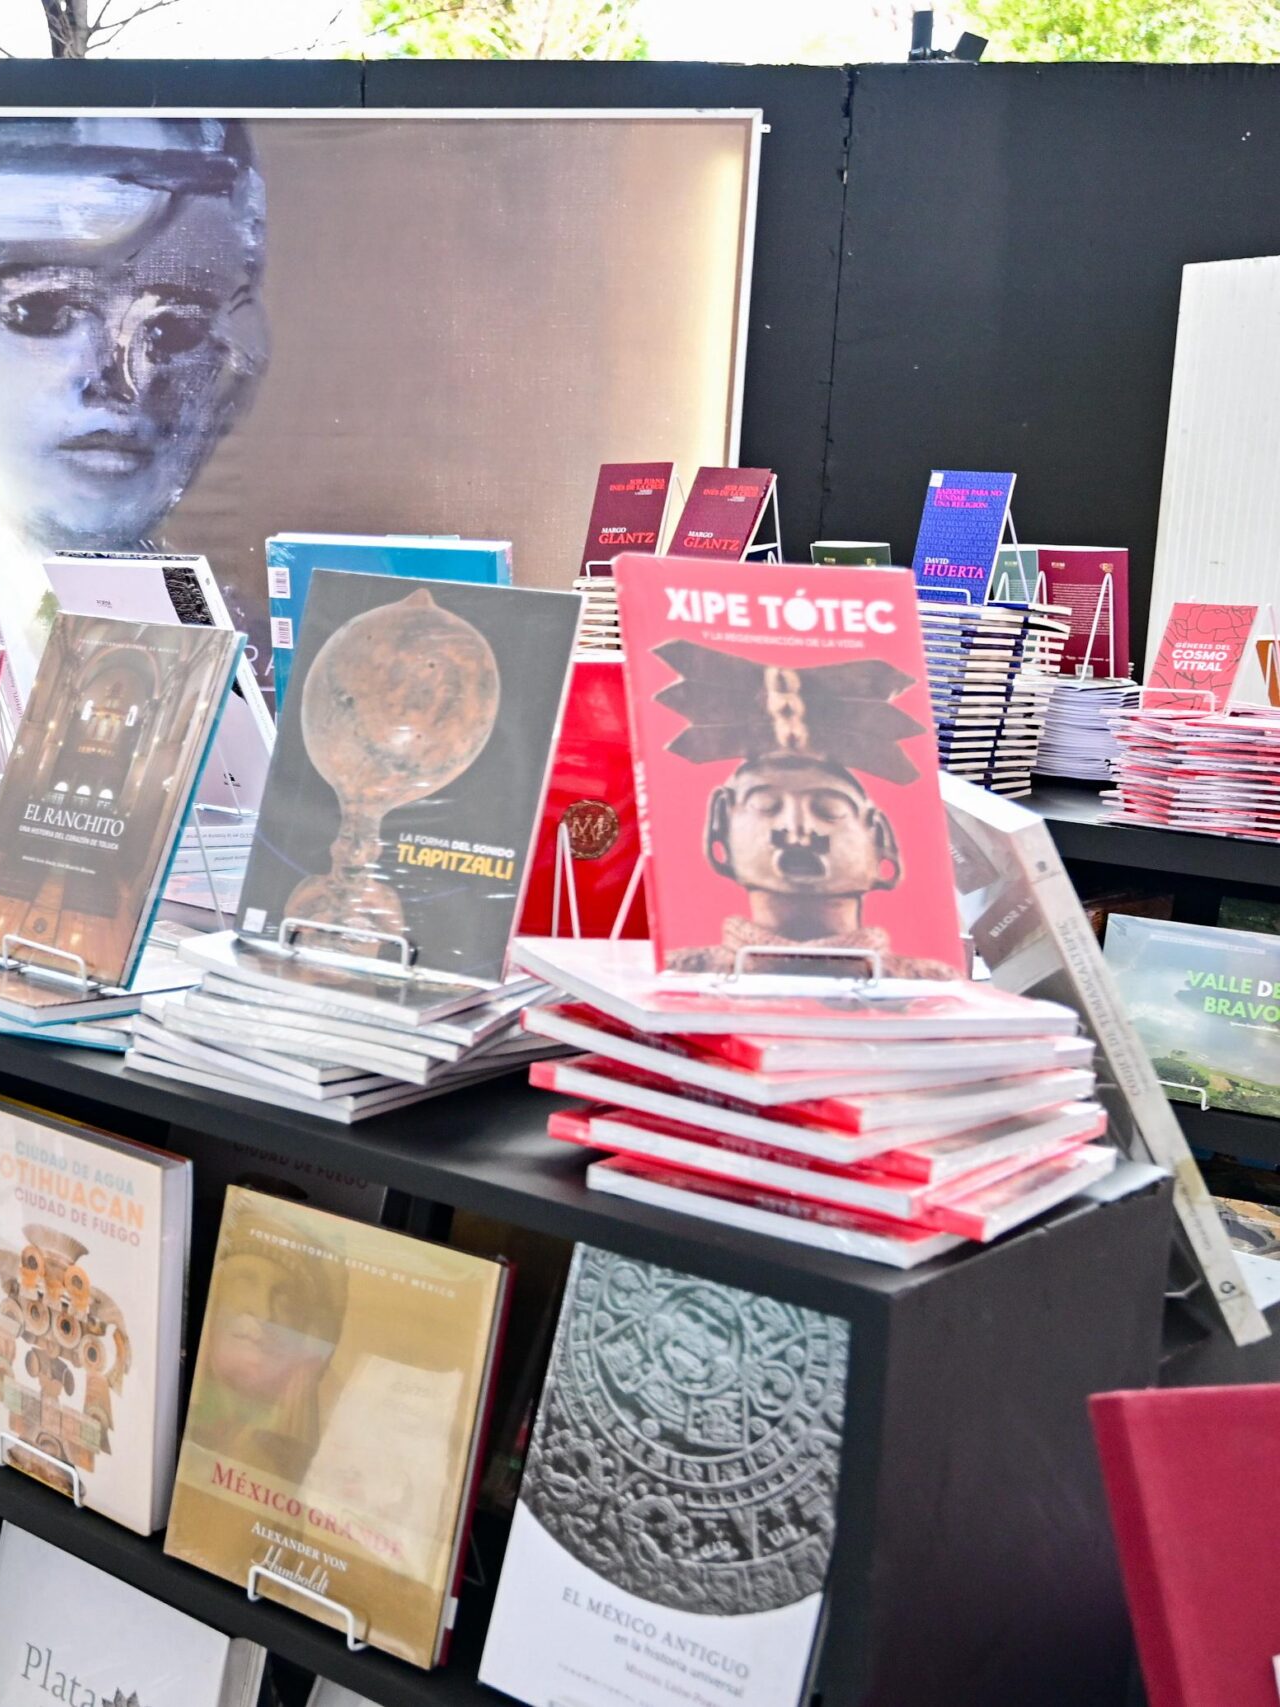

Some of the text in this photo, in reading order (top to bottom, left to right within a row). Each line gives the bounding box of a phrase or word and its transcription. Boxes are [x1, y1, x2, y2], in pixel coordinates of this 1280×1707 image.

[598, 532, 655, 545] GLANTZ
[683, 537, 740, 551] GLANTZ
[687, 530, 714, 538] MARGO
[922, 563, 985, 580] HUERTA
[925, 556, 950, 565] DAVID
[664, 587, 898, 635] XIPE TÓTEC
[1171, 649, 1228, 661] COSMO
[1172, 660, 1223, 672] VITRAL
[23, 803, 125, 838] EL RANCHITO
[396, 842, 515, 881] TLAPITZALLI
[399, 832, 516, 859] LA FORMA DEL SONIDO
[1186, 970, 1254, 995] VALLE
[1202, 996, 1280, 1023] BRAVO
[15, 1140, 135, 1196] CIUDAD DE AGUA
[14, 1186, 142, 1248] CIUDAD DE FUEGO
[344, 1256, 456, 1299] ESTADO DE MÉXICO
[211, 1460, 403, 1561] MÉXICO GRANDE
[250, 1521, 349, 1573] ALEXANDER VON
[250, 1544, 330, 1595] Humboldt
[561, 1586, 751, 1680] EL MÉXICO ANTIGUO
[20, 1641, 96, 1707] Plata
[613, 1632, 629, 1645] en
[643, 1643, 688, 1675] historia
[689, 1667, 746, 1700] universal
